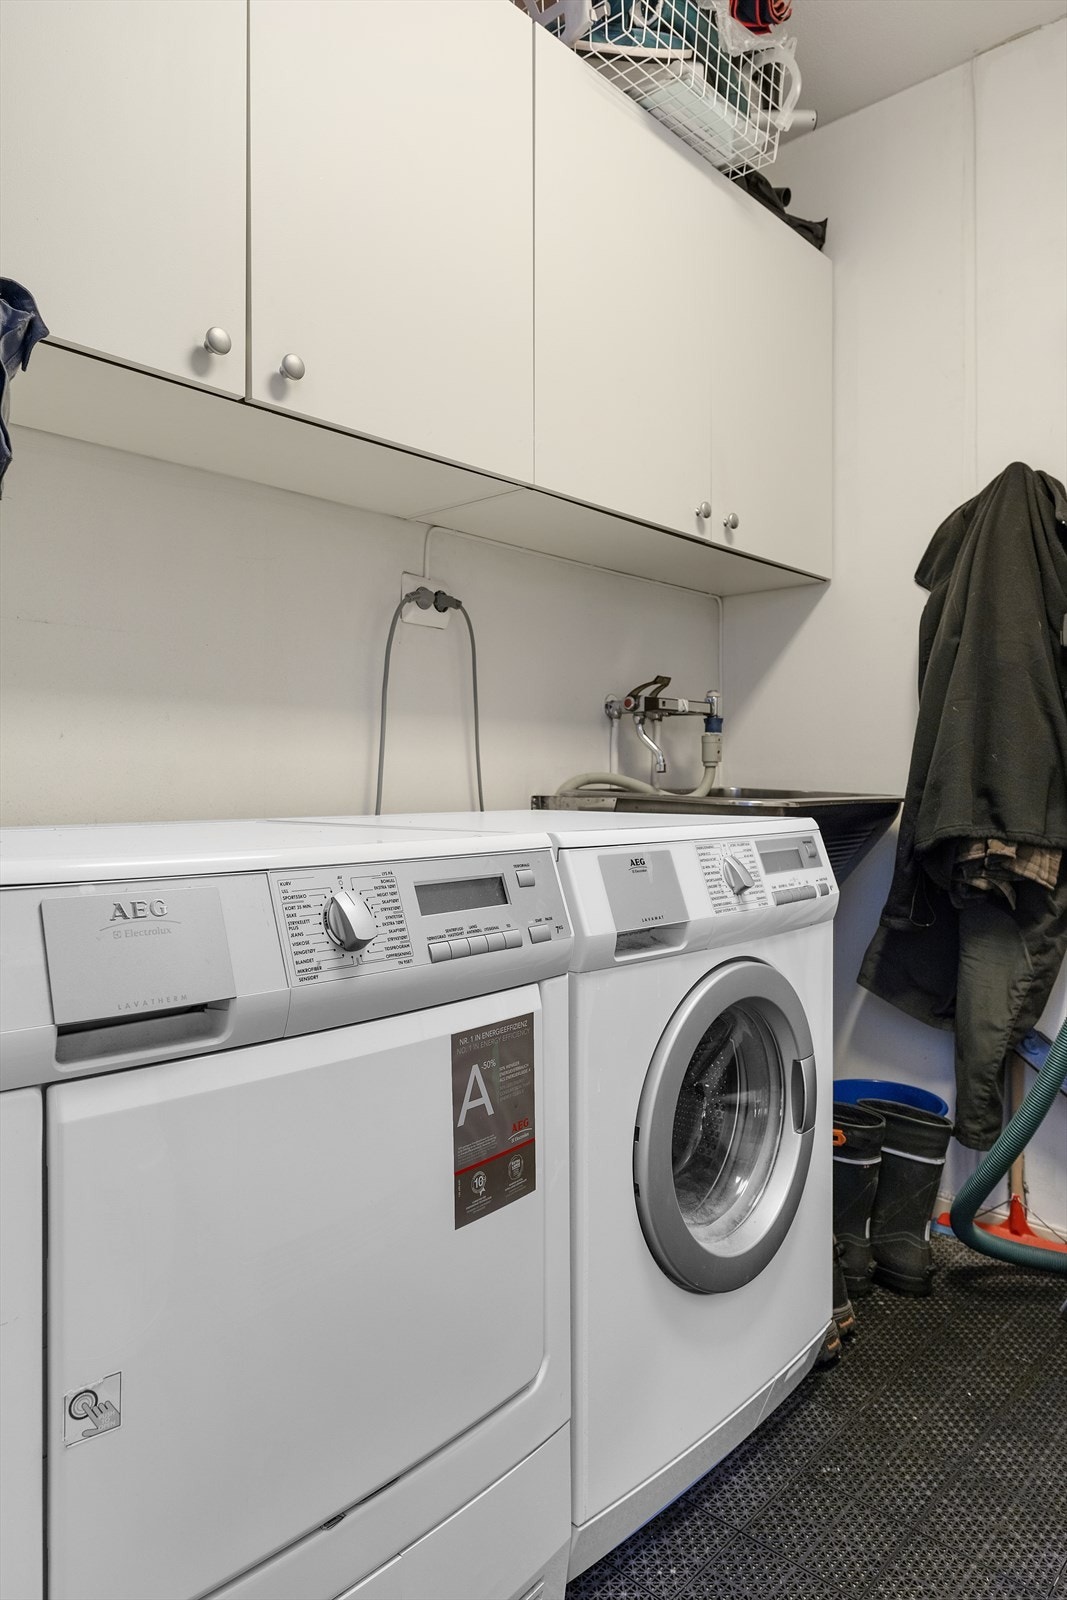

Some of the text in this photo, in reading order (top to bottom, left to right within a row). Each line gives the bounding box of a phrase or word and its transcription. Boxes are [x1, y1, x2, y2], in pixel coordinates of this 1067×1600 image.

[630, 858, 646, 867] AEG
[109, 898, 169, 922] AEG
[124, 927, 172, 938] Electrolux
[297, 965, 322, 974] MIKROFIBER
[118, 994, 188, 1010] LAVATHERM
[502, 1028, 530, 1042] EFFICIENCY
[481, 1058, 497, 1070] -50%
[456, 1063, 495, 1128] A
[512, 1117, 529, 1133] AEG
